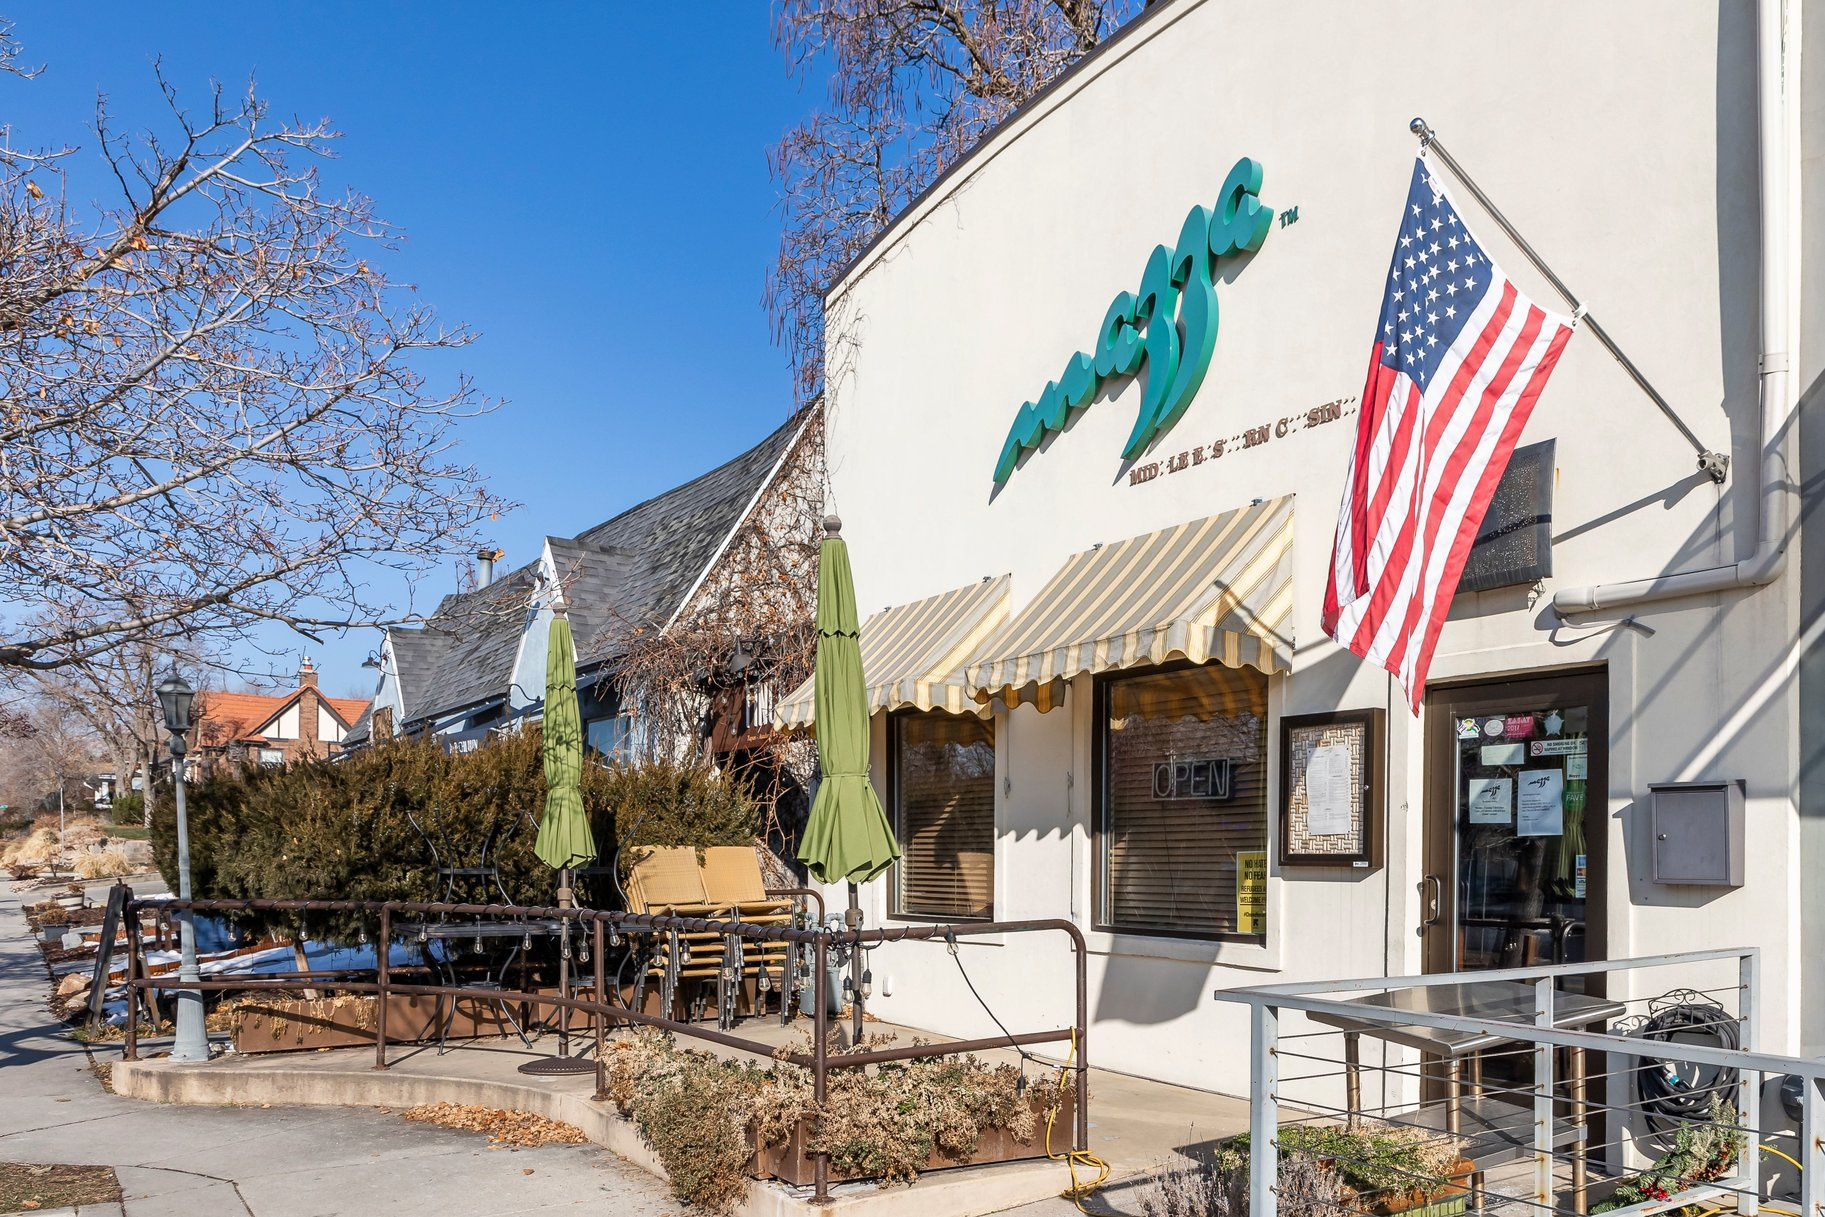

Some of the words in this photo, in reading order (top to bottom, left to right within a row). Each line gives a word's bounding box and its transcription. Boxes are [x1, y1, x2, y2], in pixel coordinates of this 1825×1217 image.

[1129, 450, 1190, 487] MIDLE
[1155, 761, 1226, 797] OPEN
[1244, 859, 1253, 868] NO
[1244, 871, 1253, 880] NO
